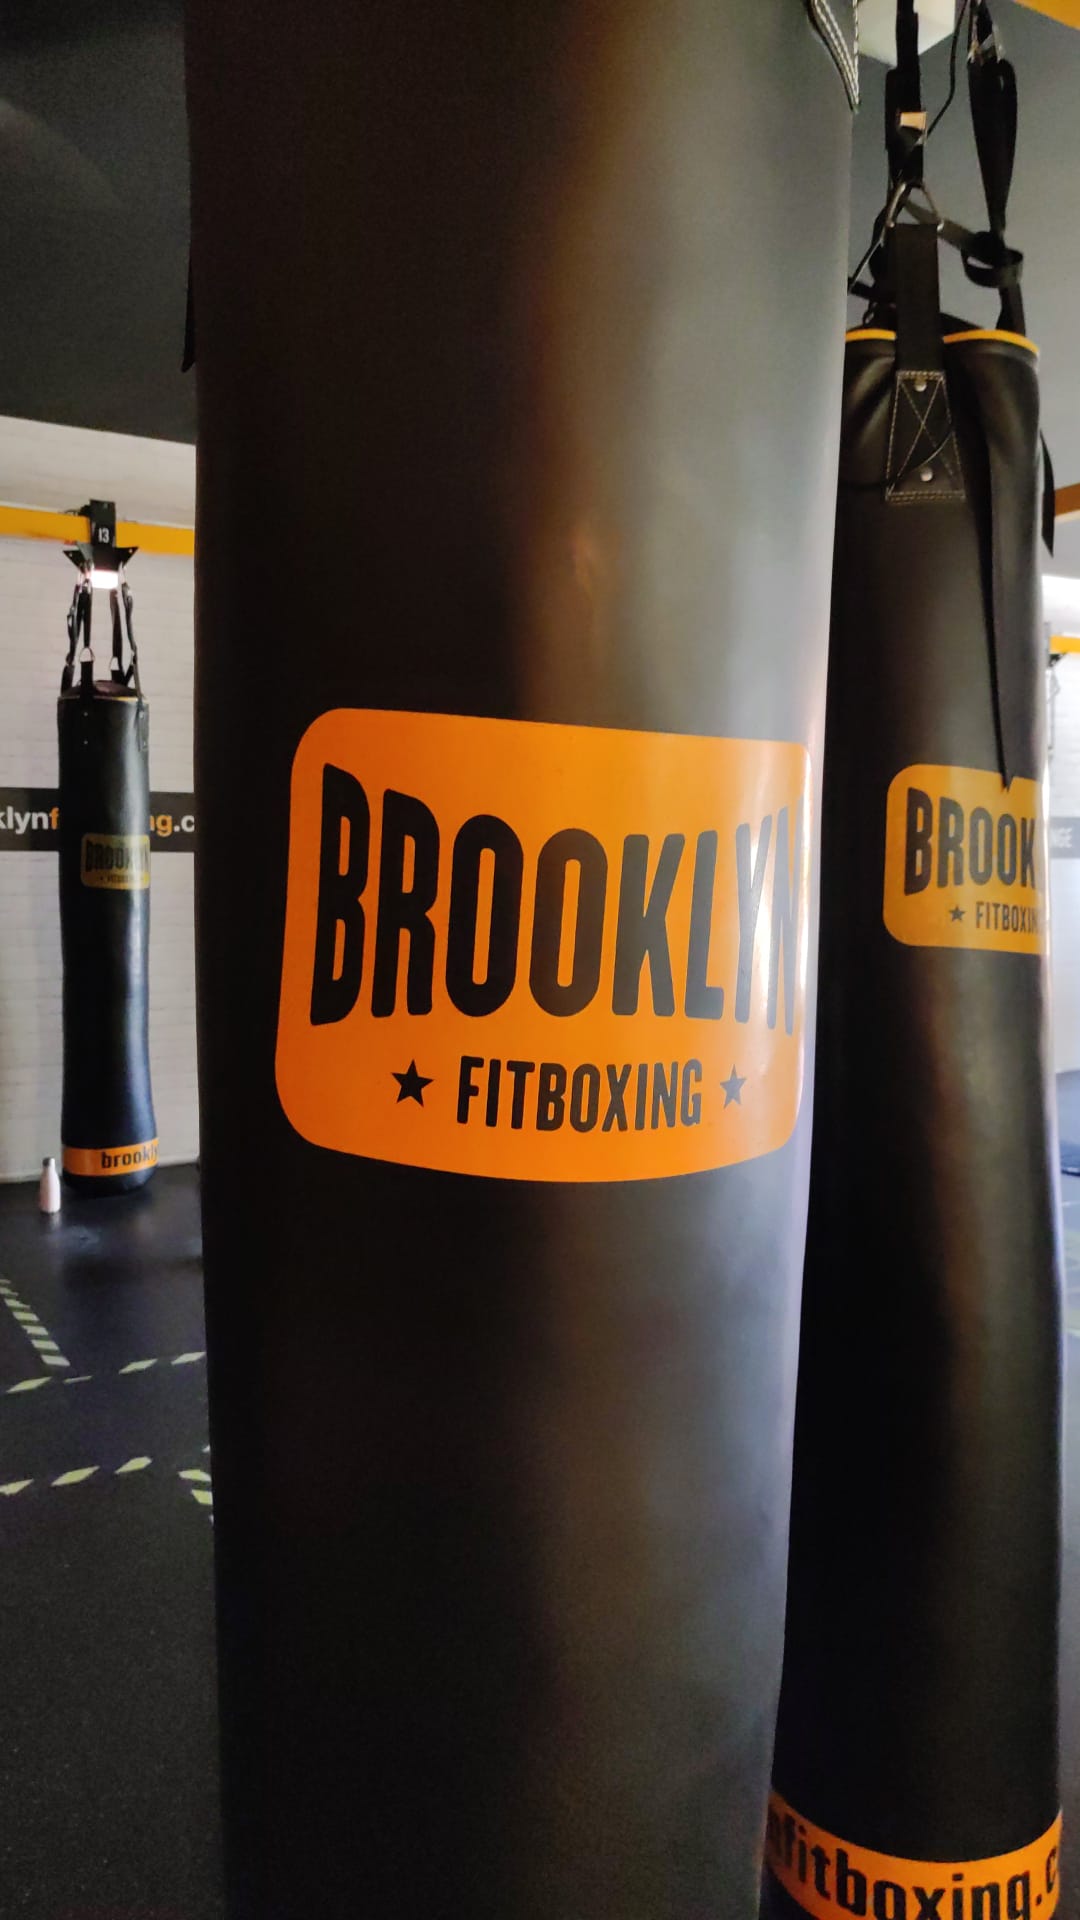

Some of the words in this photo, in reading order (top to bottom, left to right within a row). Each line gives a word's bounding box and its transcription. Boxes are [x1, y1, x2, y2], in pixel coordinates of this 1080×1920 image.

[98, 527, 110, 543] 13
[310, 763, 804, 1036] BROOKLYN
[456, 1056, 703, 1133] FITBOXING
